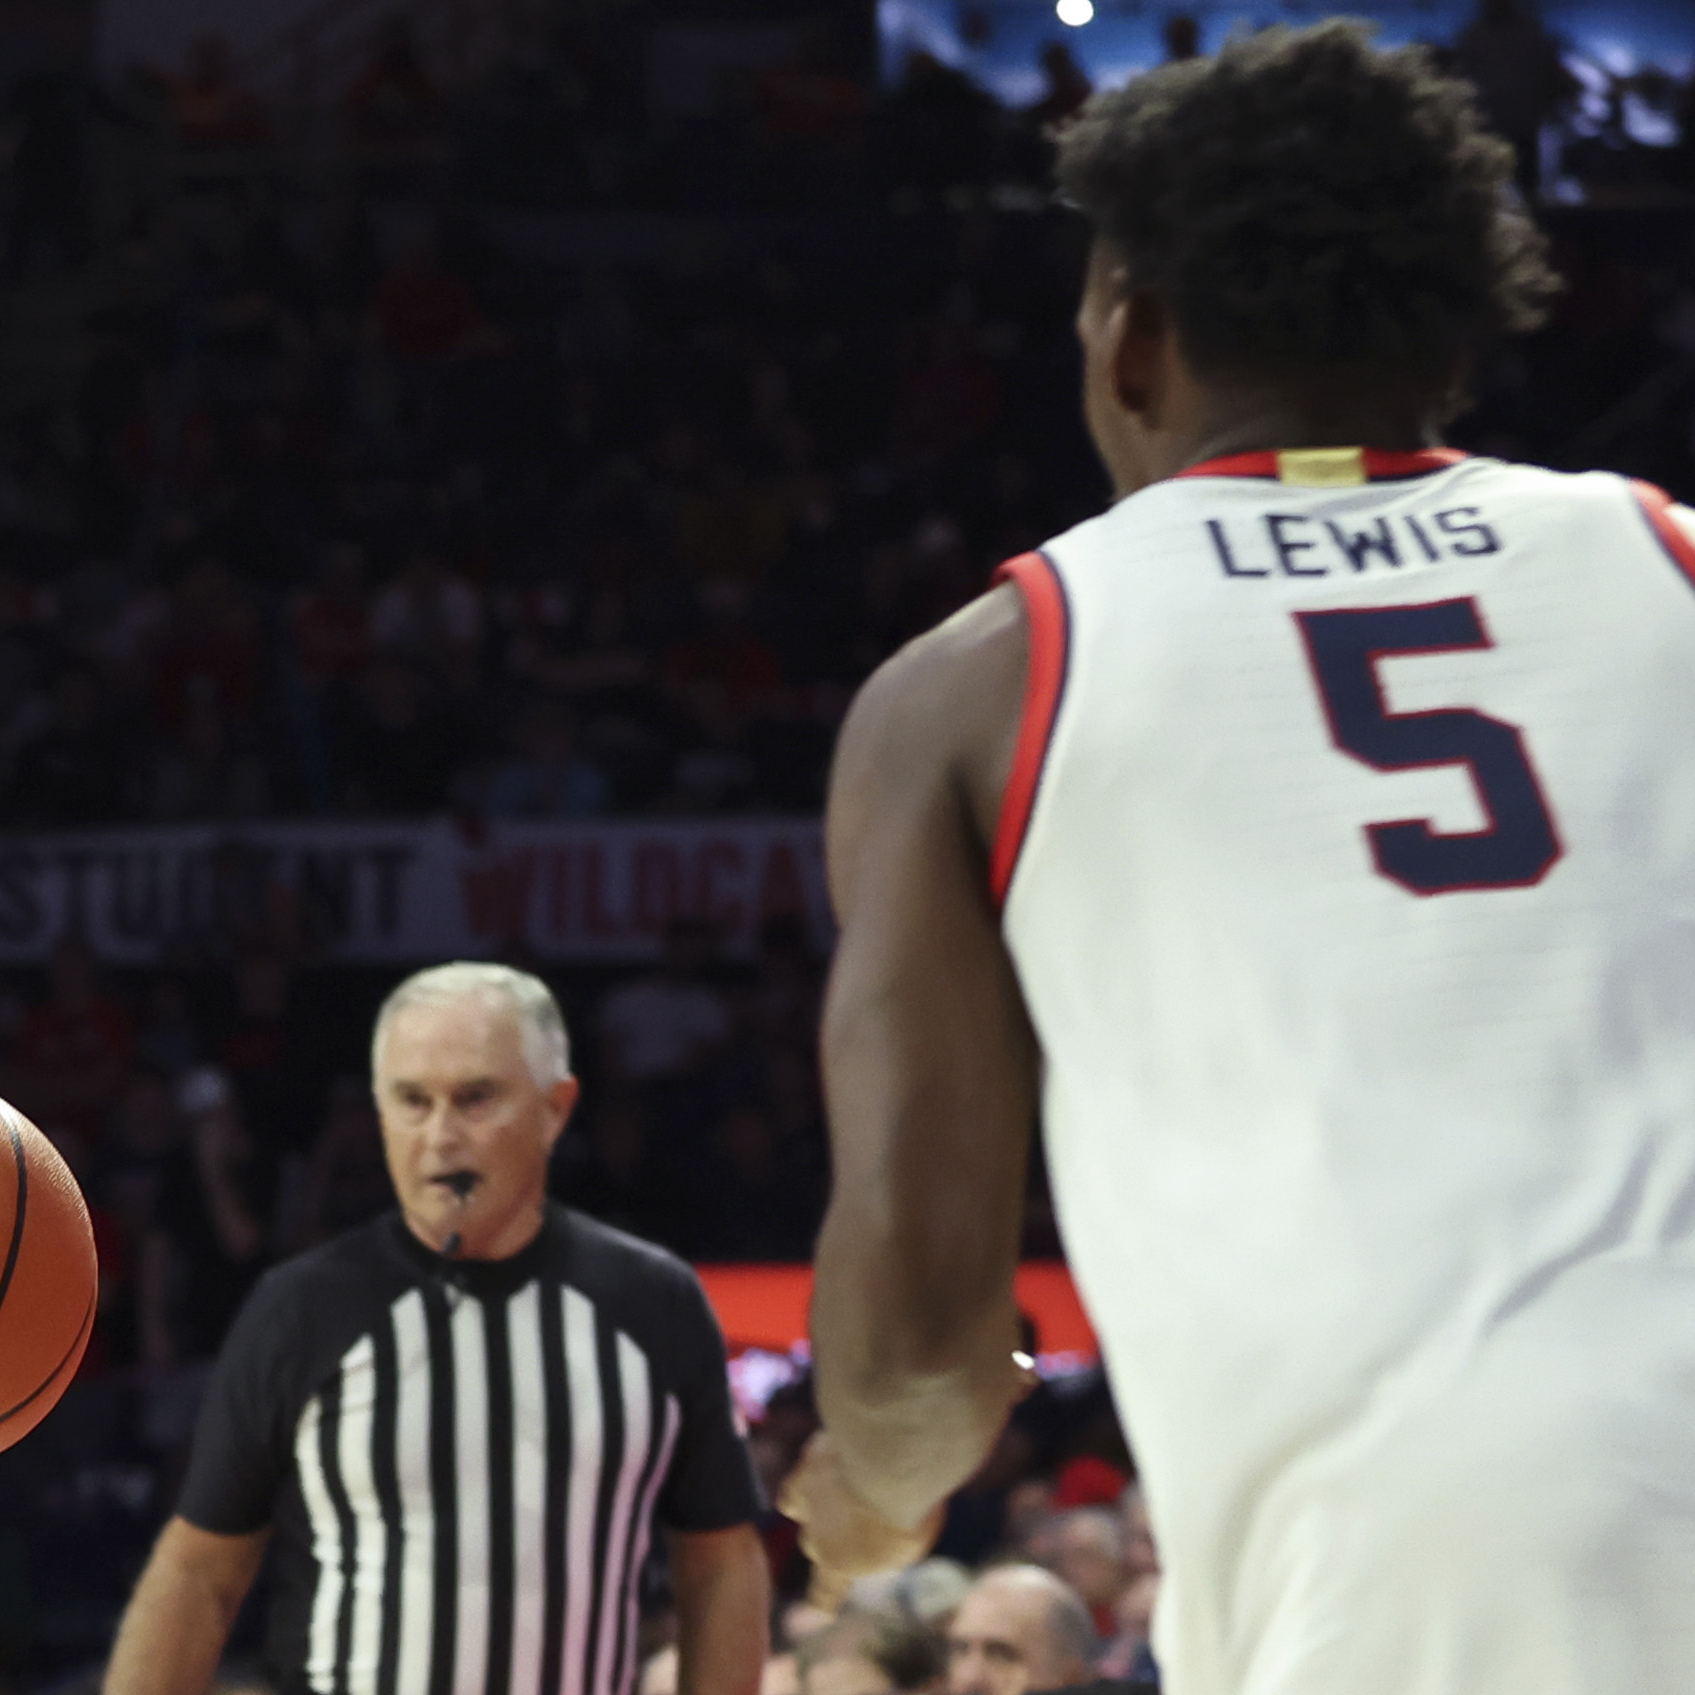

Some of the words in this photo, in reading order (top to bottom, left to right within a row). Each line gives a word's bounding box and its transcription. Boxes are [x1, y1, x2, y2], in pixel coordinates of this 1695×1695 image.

[1206, 505, 1503, 579] LEWIS
[1290, 595, 1566, 898] 5
[460, 841, 809, 941] WILDCA
